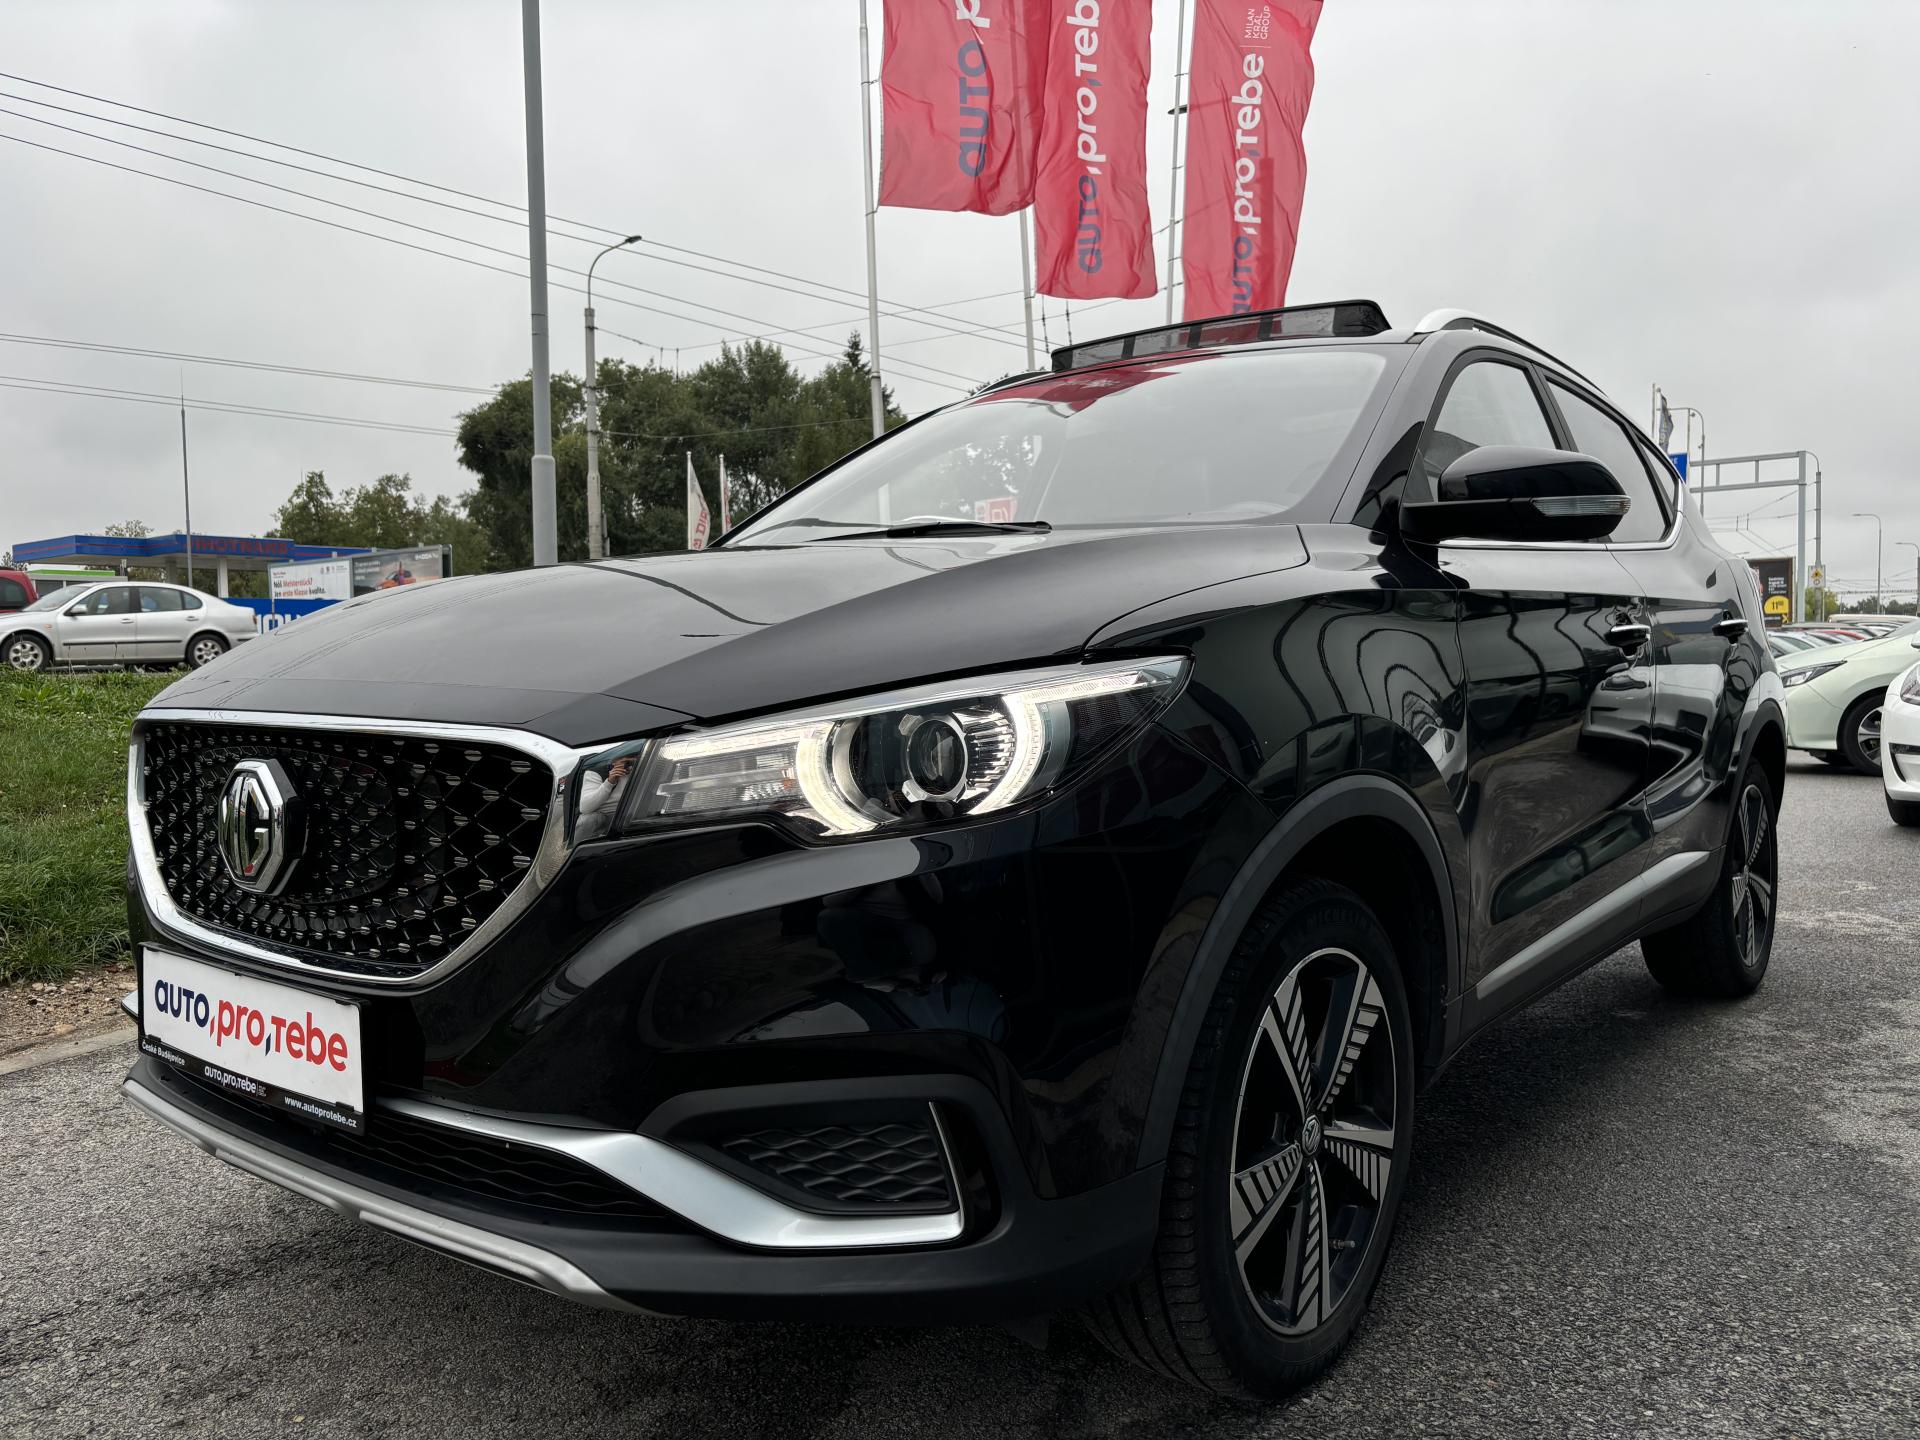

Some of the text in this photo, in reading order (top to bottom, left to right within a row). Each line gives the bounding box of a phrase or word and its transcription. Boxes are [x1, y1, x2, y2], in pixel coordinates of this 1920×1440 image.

[1244, 8, 1256, 39] MILAN
[1260, 5, 1271, 40] GROUP
[284, 1096, 357, 1128] www.autoprotebe.cz
